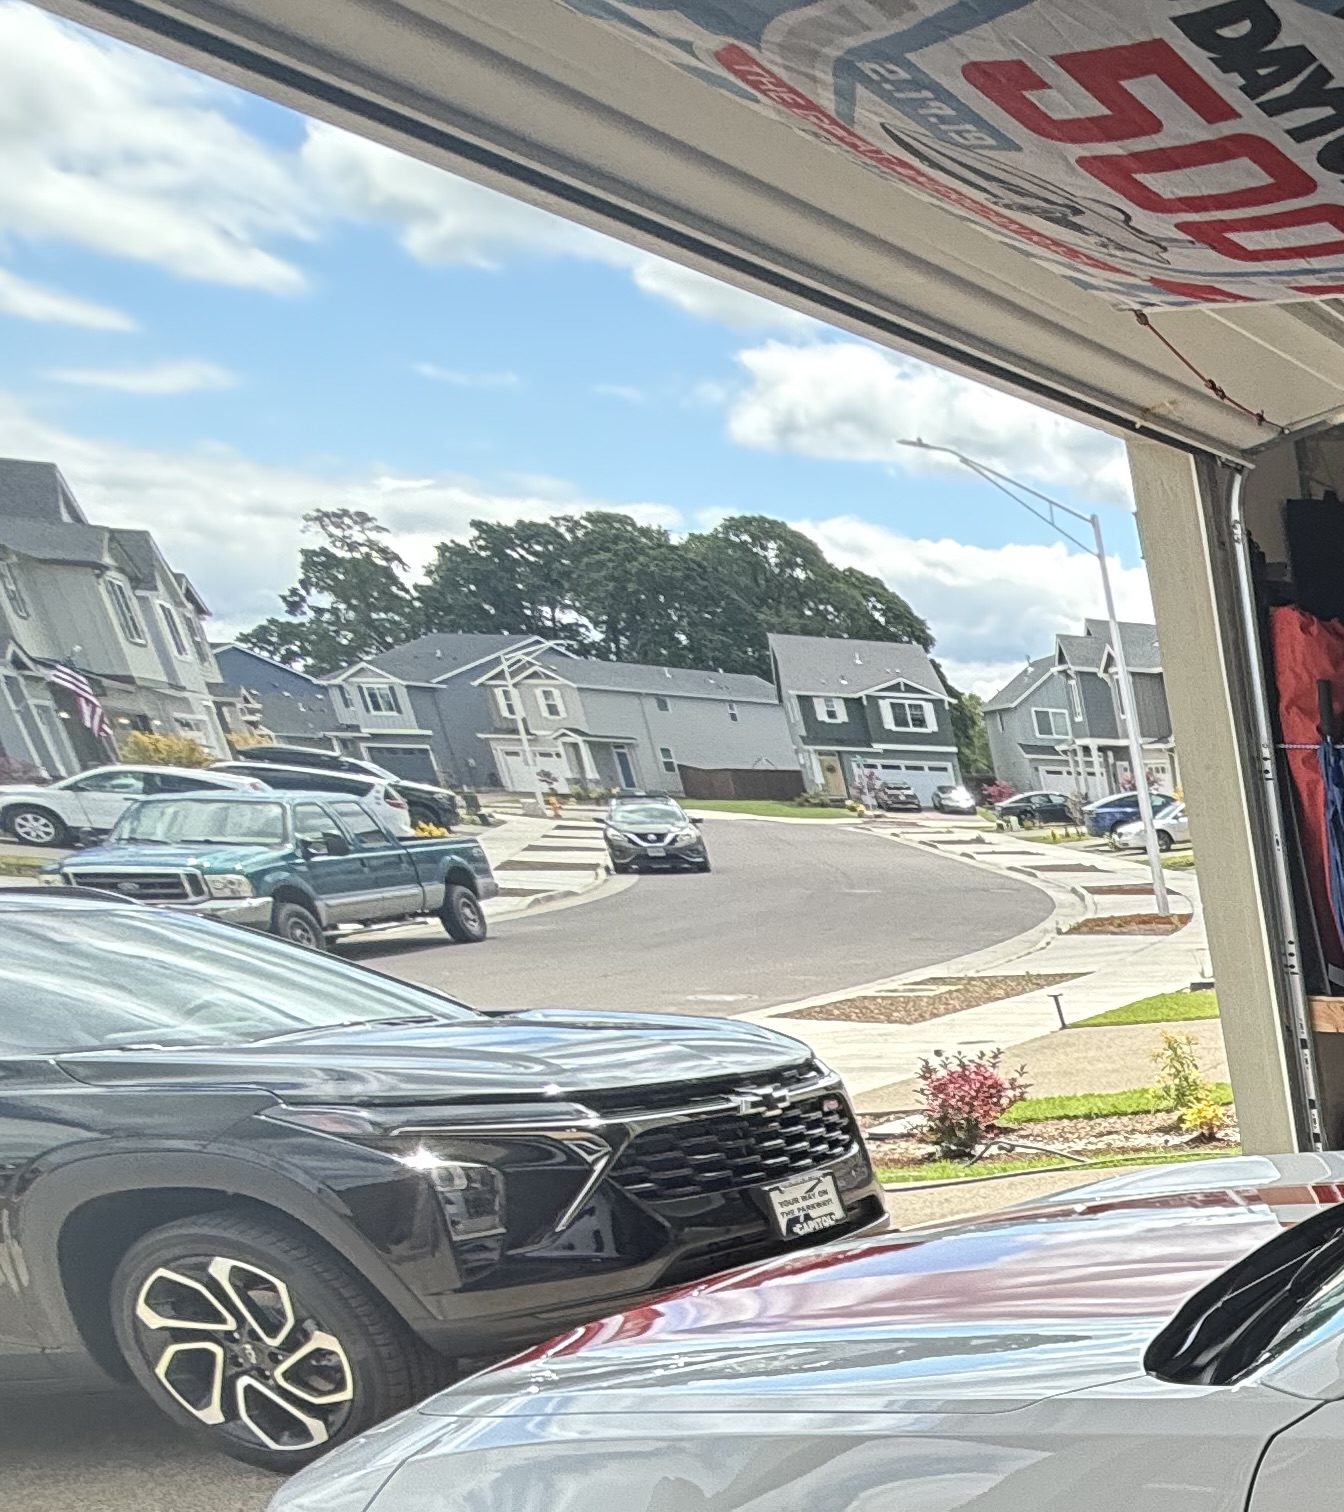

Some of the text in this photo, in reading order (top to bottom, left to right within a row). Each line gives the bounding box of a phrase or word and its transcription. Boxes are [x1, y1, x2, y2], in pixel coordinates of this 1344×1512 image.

[733, 64, 806, 106] THE
[777, 1188, 829, 1209] YOUR WAY ON
[780, 1209, 796, 1219] THE
[795, 1213, 837, 1236] CAPITOL
